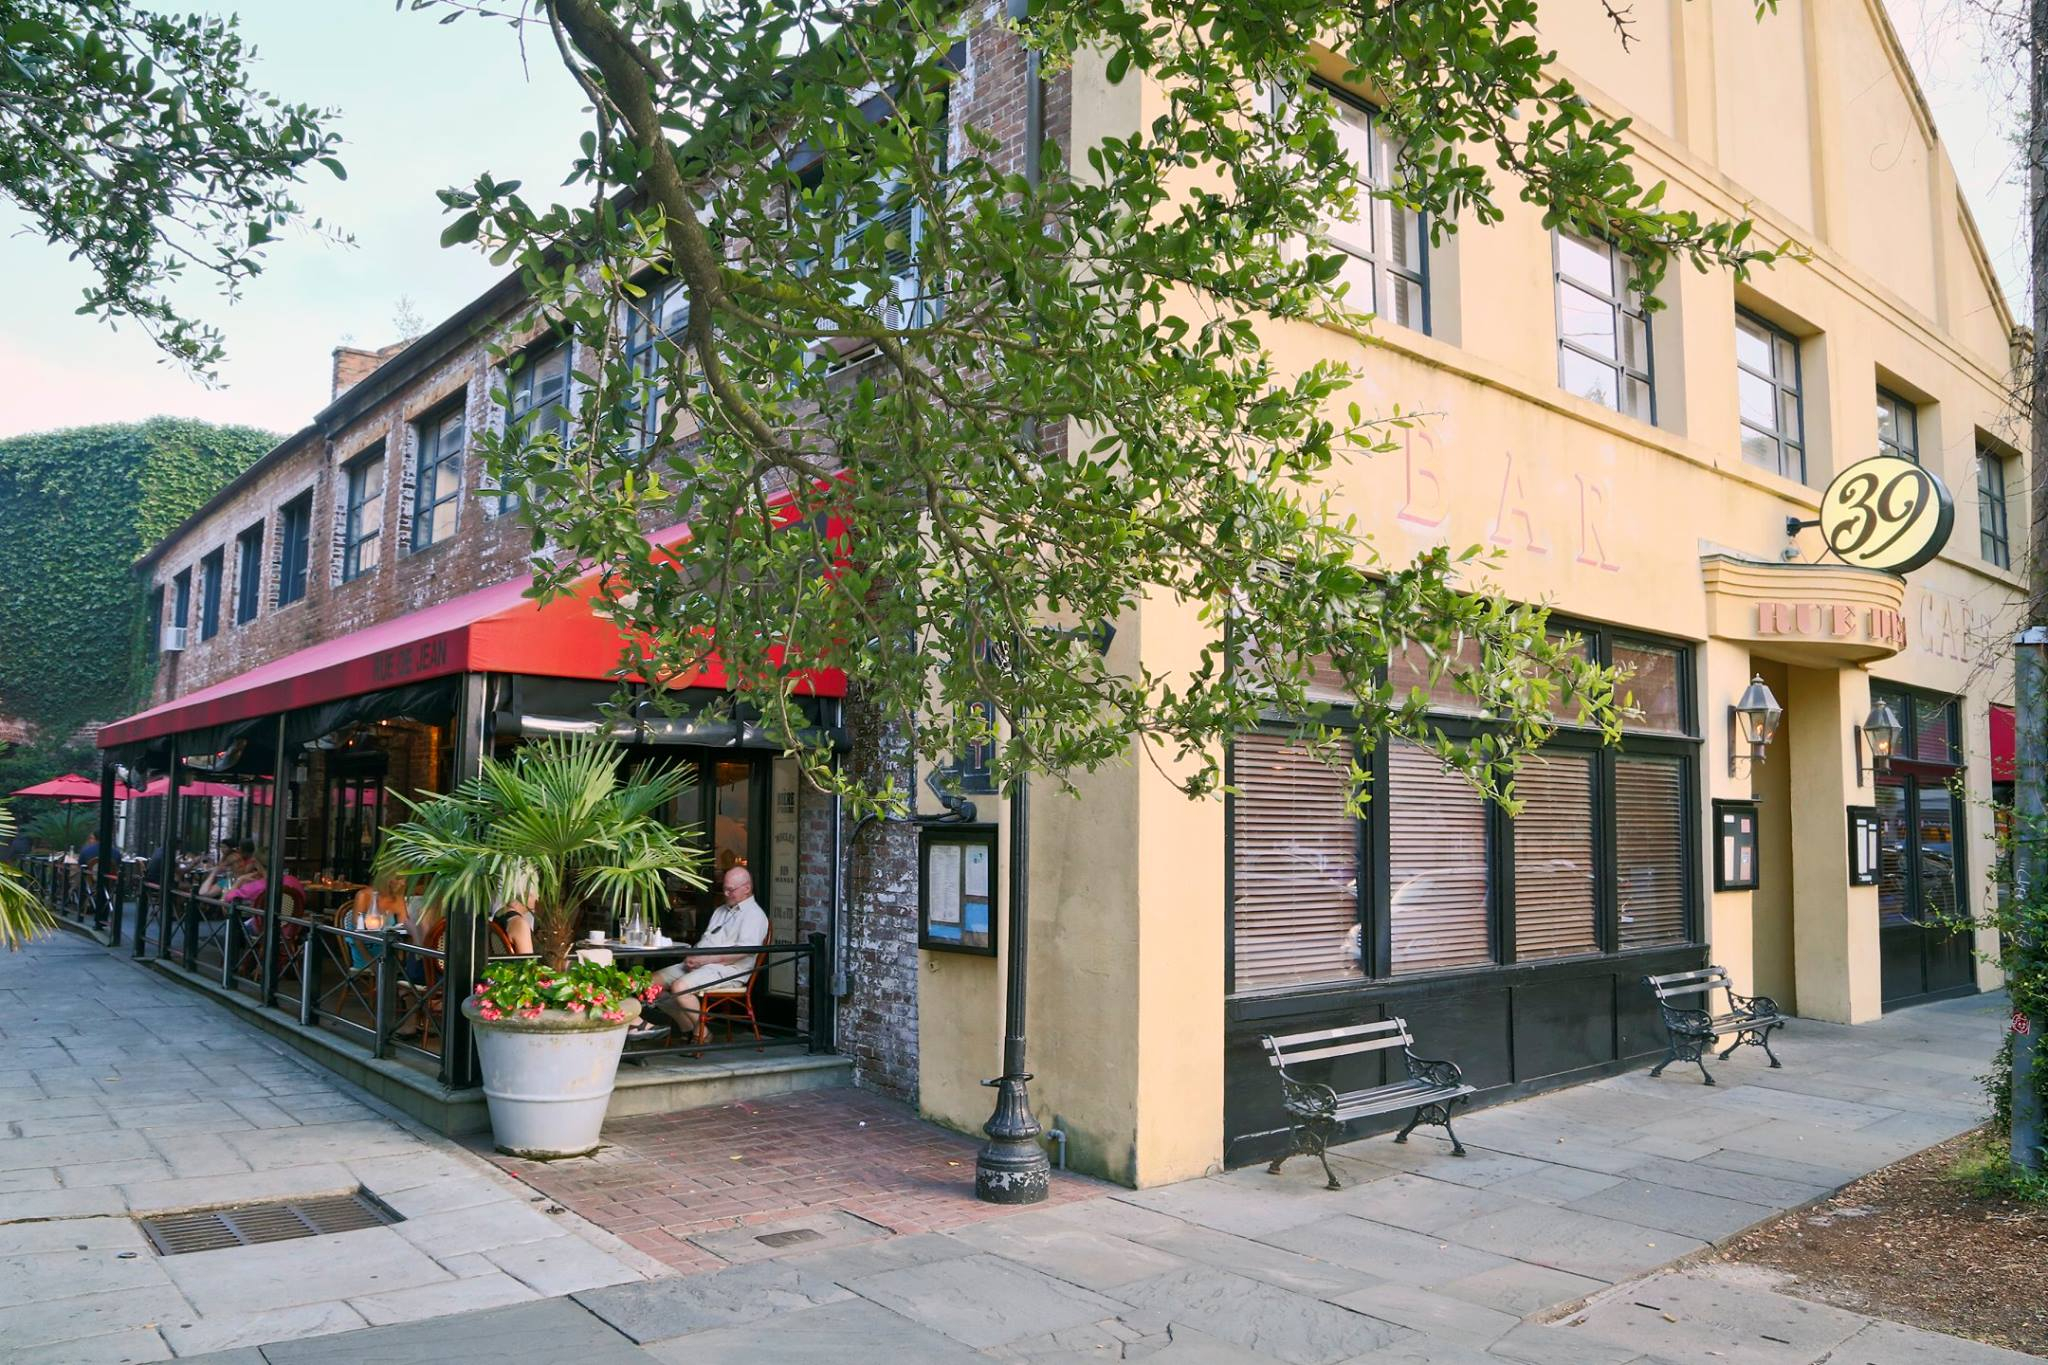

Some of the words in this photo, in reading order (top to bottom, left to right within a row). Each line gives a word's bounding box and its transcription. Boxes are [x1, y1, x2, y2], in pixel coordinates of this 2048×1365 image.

[1397, 425, 1621, 573] BAR
[1830, 469, 1931, 560] 39
[1755, 602, 1856, 636] RUE
[417, 639, 447, 671] JEAN
